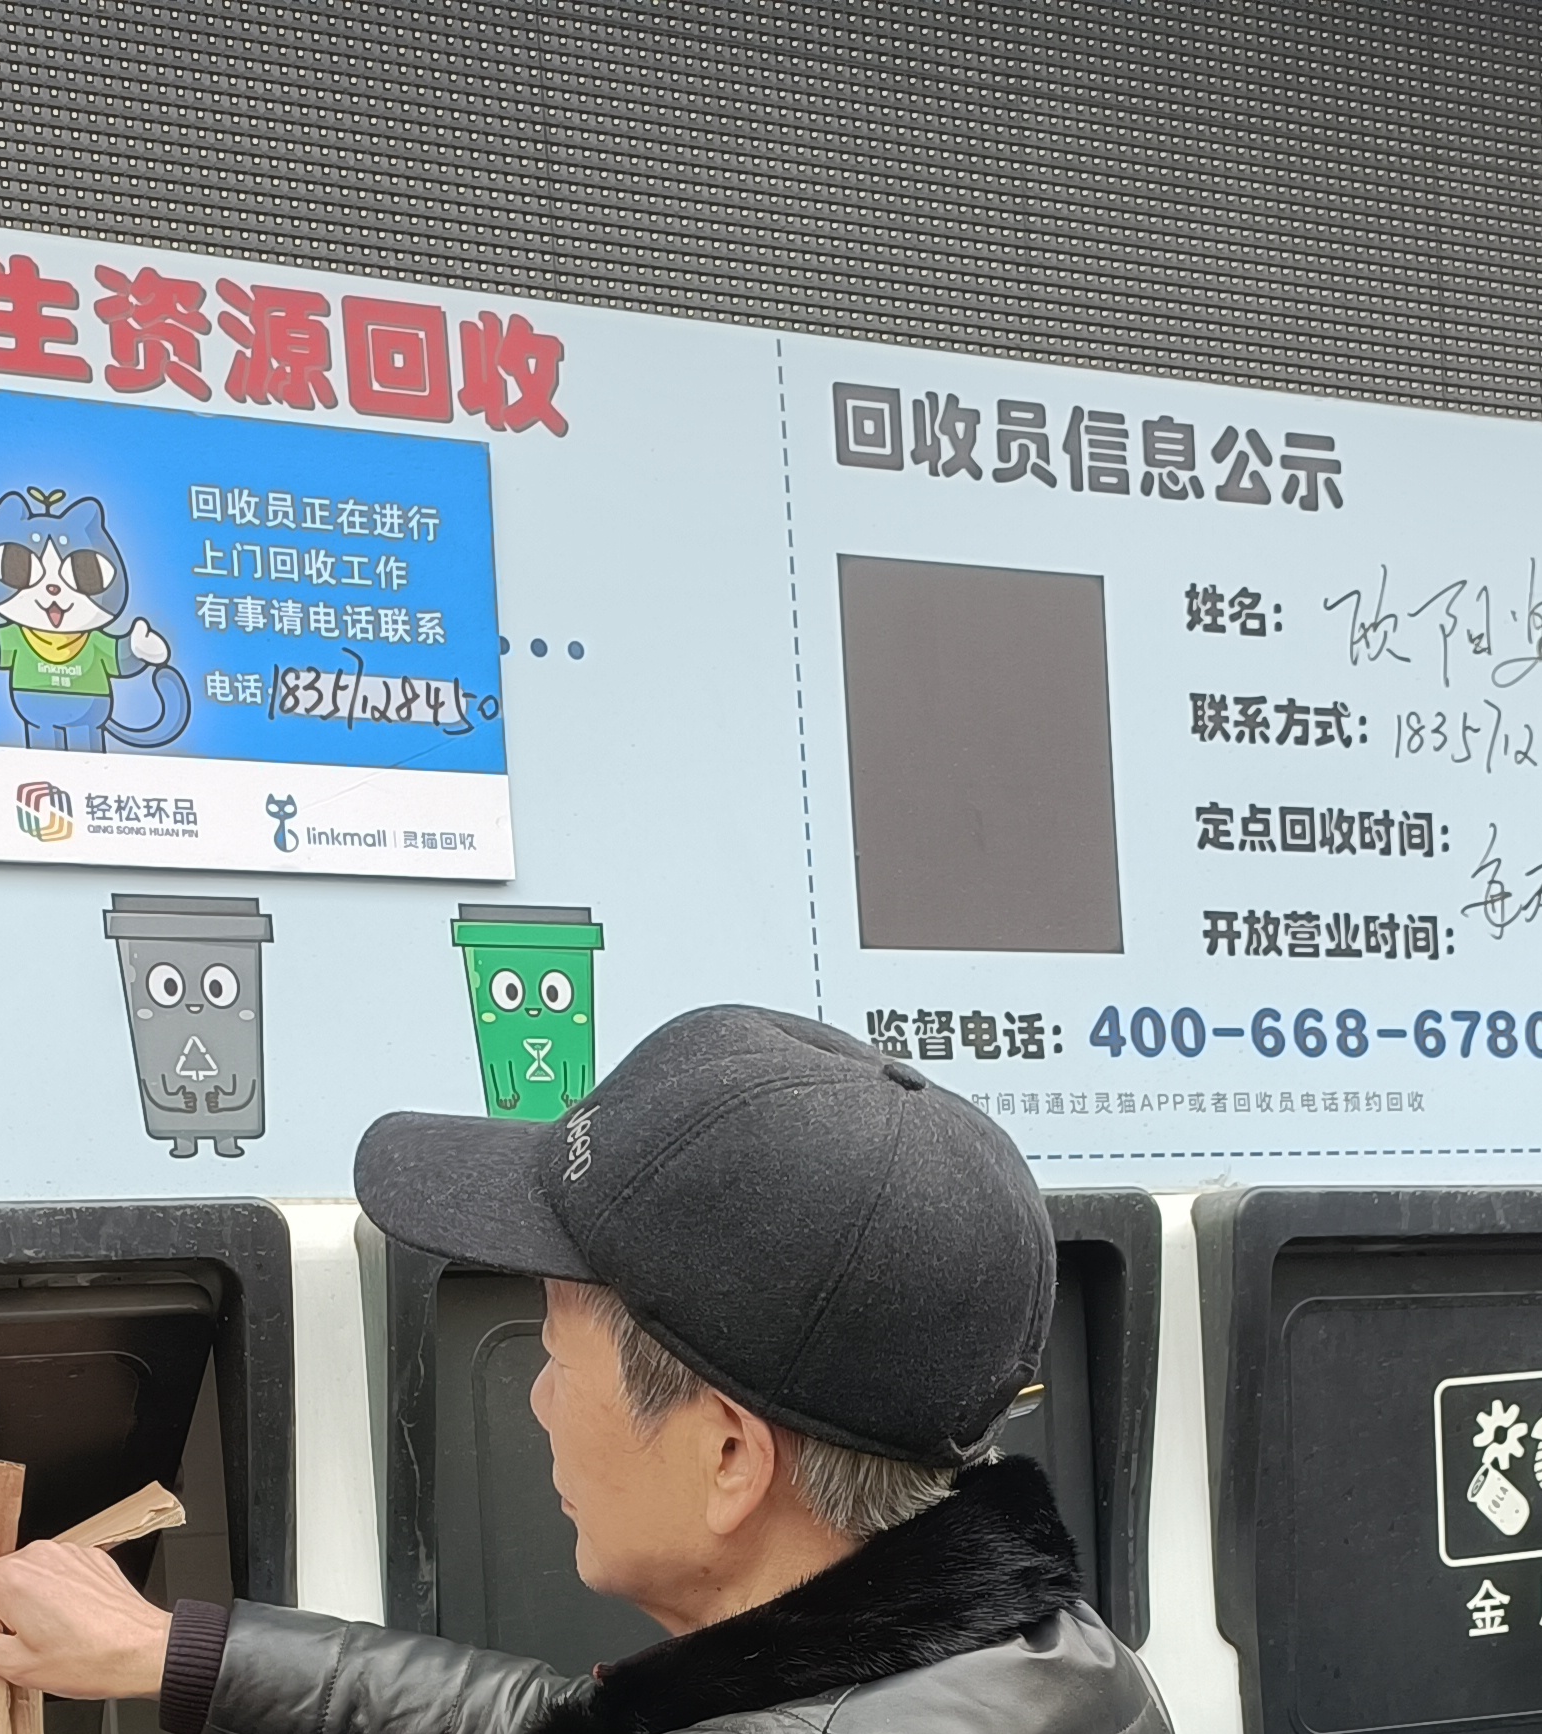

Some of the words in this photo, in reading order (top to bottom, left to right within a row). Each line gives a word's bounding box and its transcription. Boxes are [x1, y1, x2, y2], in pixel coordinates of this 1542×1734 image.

[832, 380, 1345, 512] 回收员信息公示
[190, 485, 441, 542] 回收员正在进行
[193, 539, 408, 591] 上门回收工作
[195, 593, 445, 645] 有事请电话联系
[85, 792, 199, 826] 轻松环品
[87, 823, 114, 836] QING
[115, 824, 147, 838] SONG
[148, 826, 180, 839] HUAN
[182, 828, 199, 839] PIN
[306, 826, 388, 849] linkmall
[403, 829, 477, 852] 灵猫回收
[562, 1104, 601, 1182] Jeep
